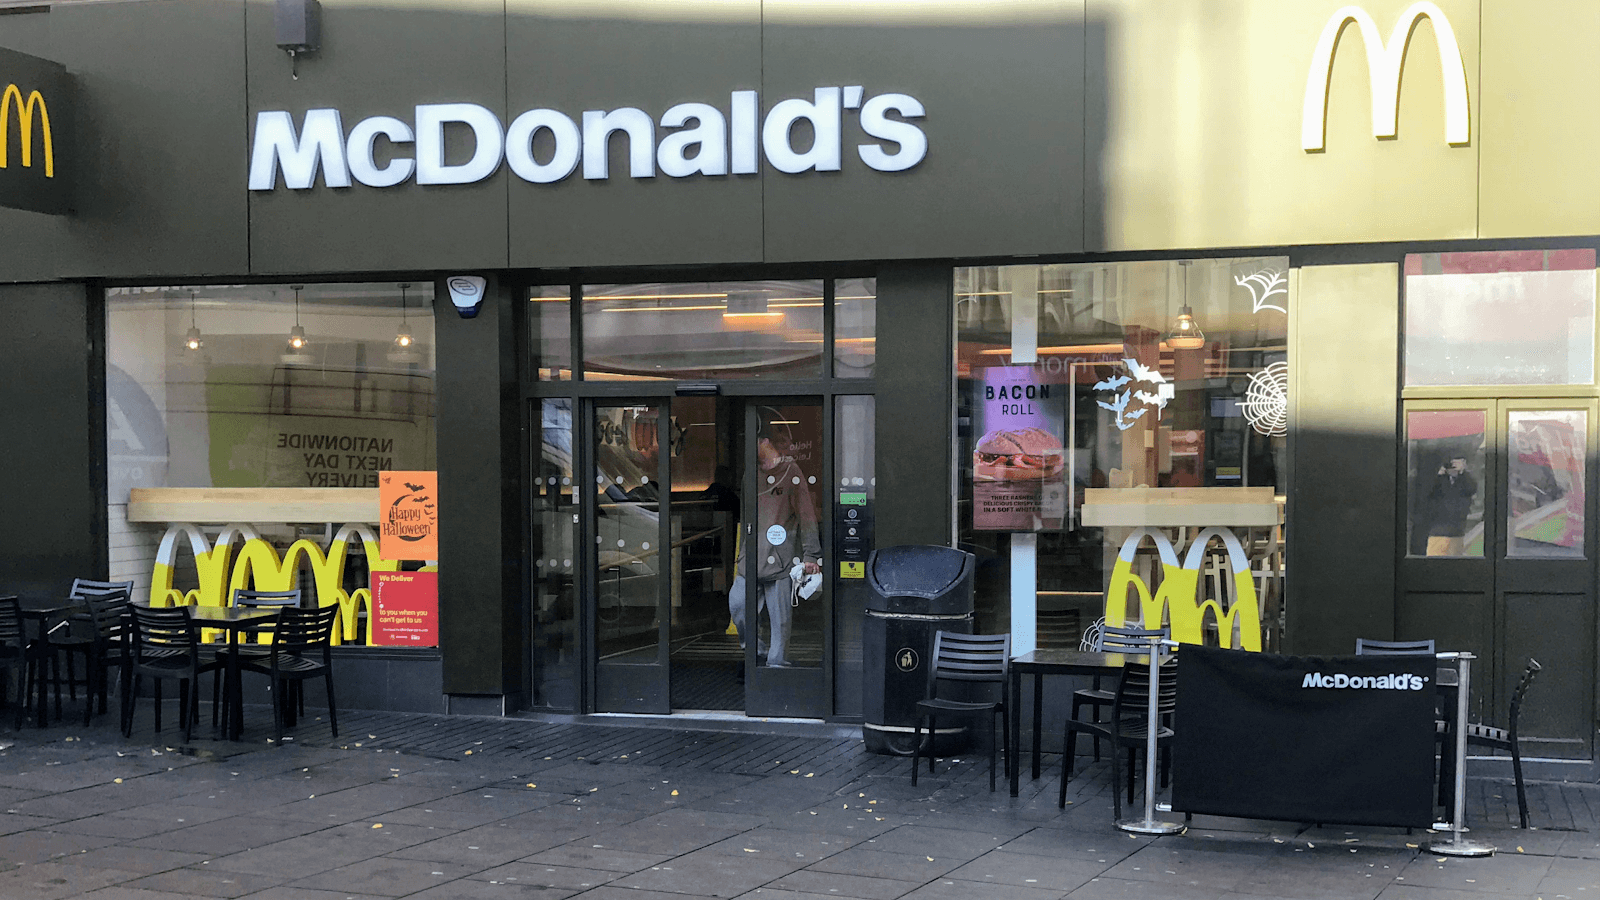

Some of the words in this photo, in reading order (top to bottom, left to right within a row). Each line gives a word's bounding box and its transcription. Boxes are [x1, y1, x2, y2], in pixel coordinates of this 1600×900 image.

[248, 86, 928, 191] McDonald's
[985, 384, 1050, 400] BACON
[1002, 404, 1035, 416] ROLL
[390, 507, 421, 521] Happy
[382, 522, 431, 536] Halloween
